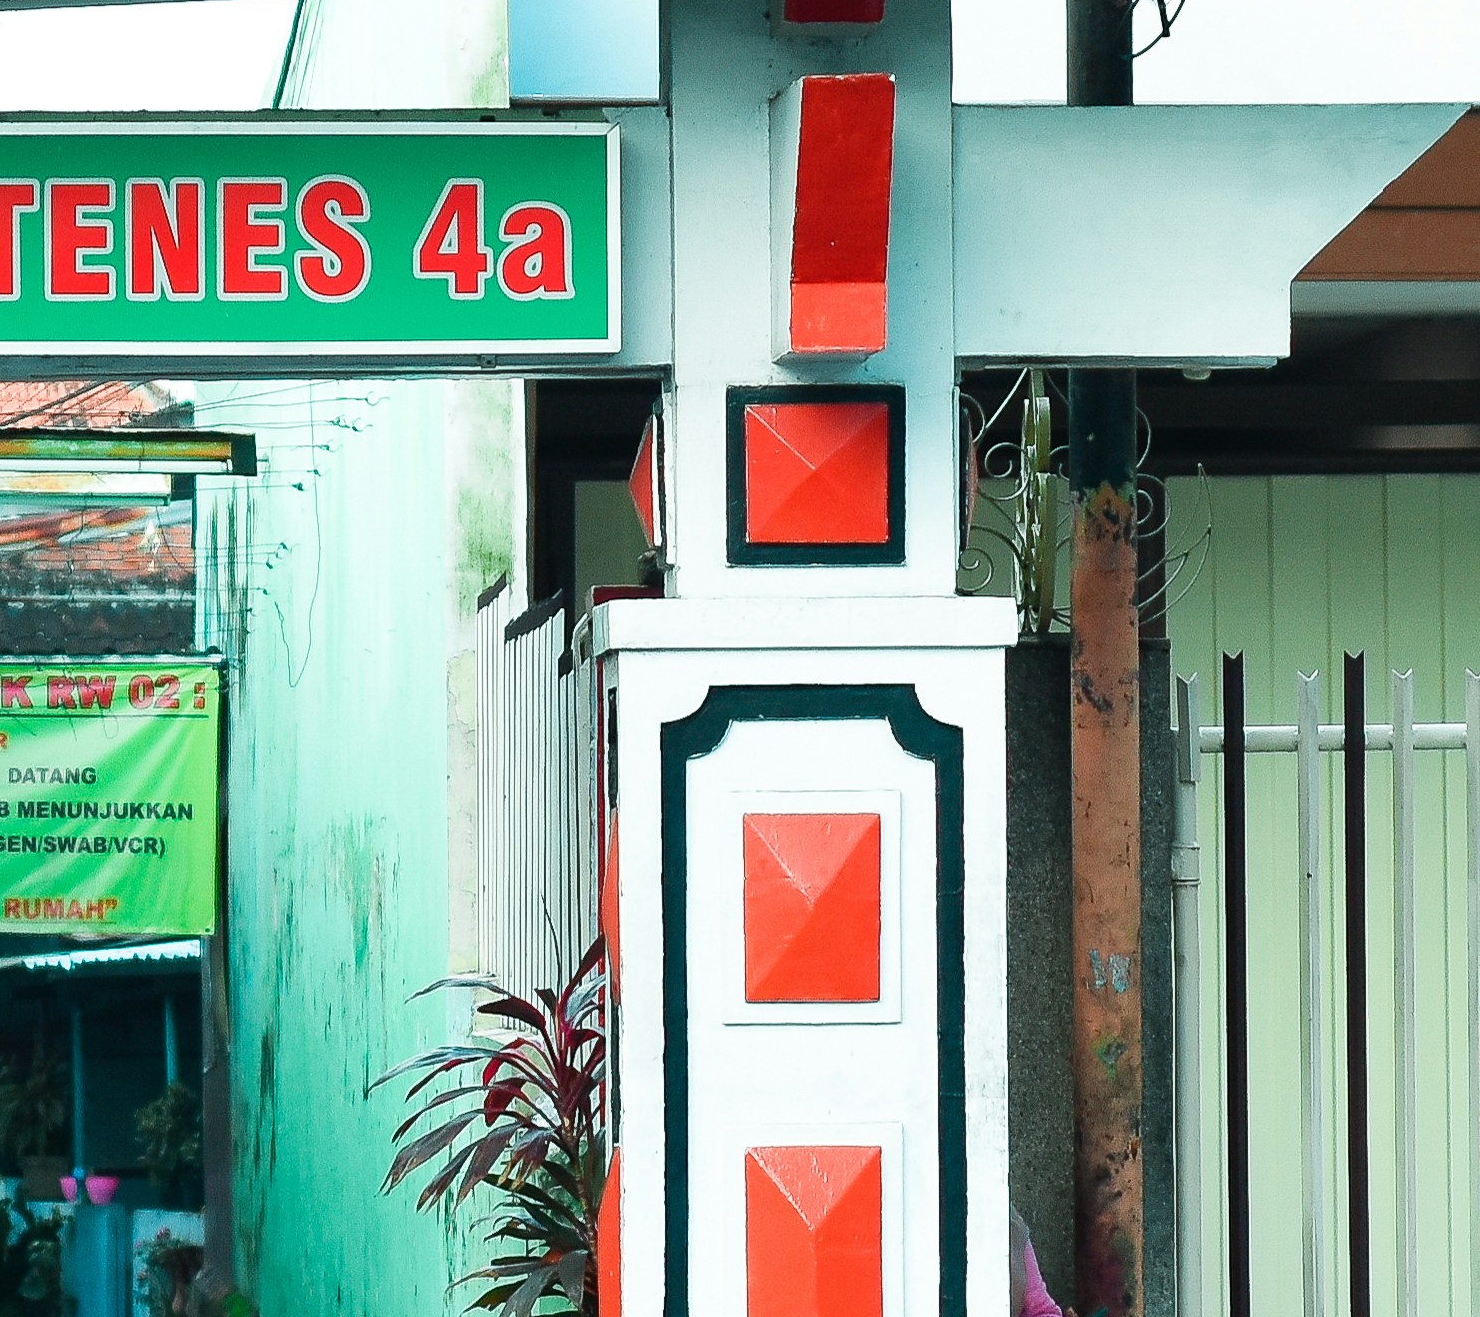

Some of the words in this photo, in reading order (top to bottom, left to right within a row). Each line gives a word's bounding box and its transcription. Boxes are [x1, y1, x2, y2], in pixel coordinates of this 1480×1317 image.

[414, 175, 575, 302] 4a
[47, 675, 116, 709] RW
[128, 675, 180, 709] 02
[8, 767, 97, 785] DATANG
[18, 801, 193, 821] MENUNJUKKAN
